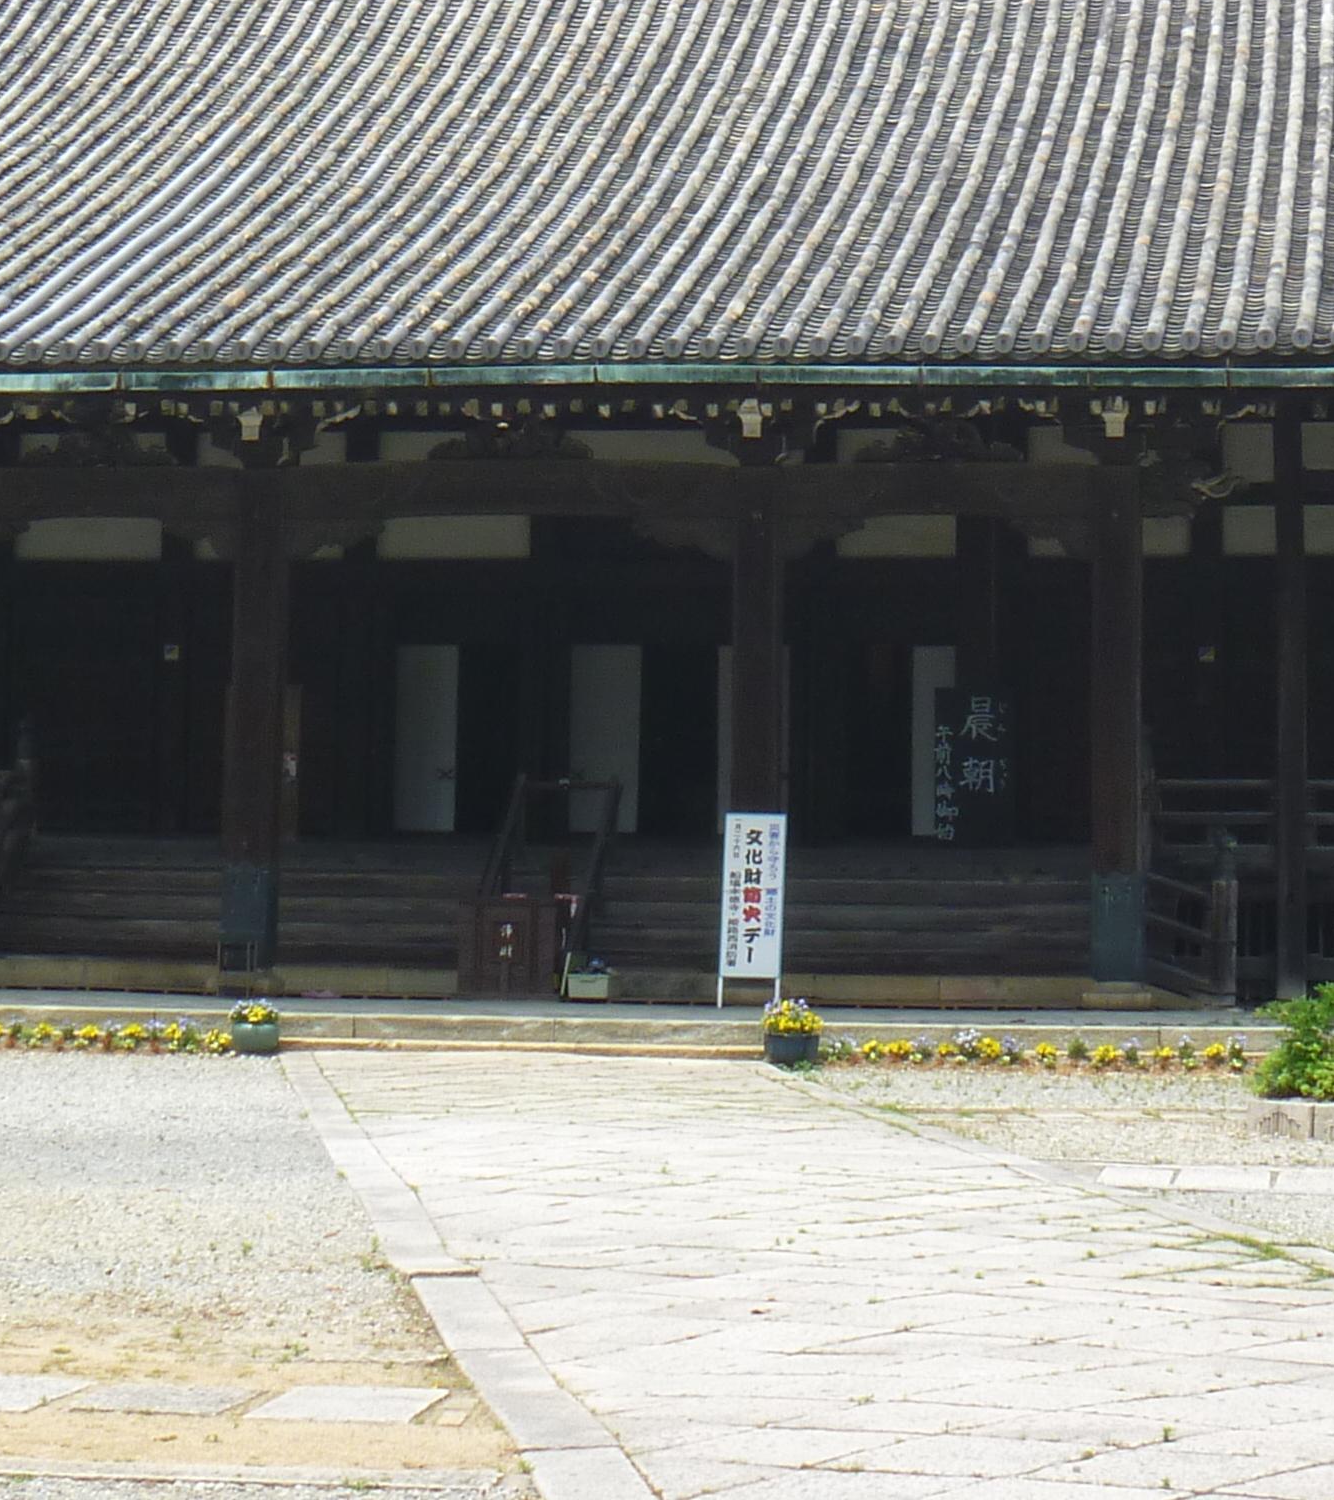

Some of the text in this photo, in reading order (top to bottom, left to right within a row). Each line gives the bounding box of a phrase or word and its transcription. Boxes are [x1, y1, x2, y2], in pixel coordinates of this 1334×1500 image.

[958, 695, 998, 795] 晨朝
[742, 828, 764, 964] 文化財防火デー
